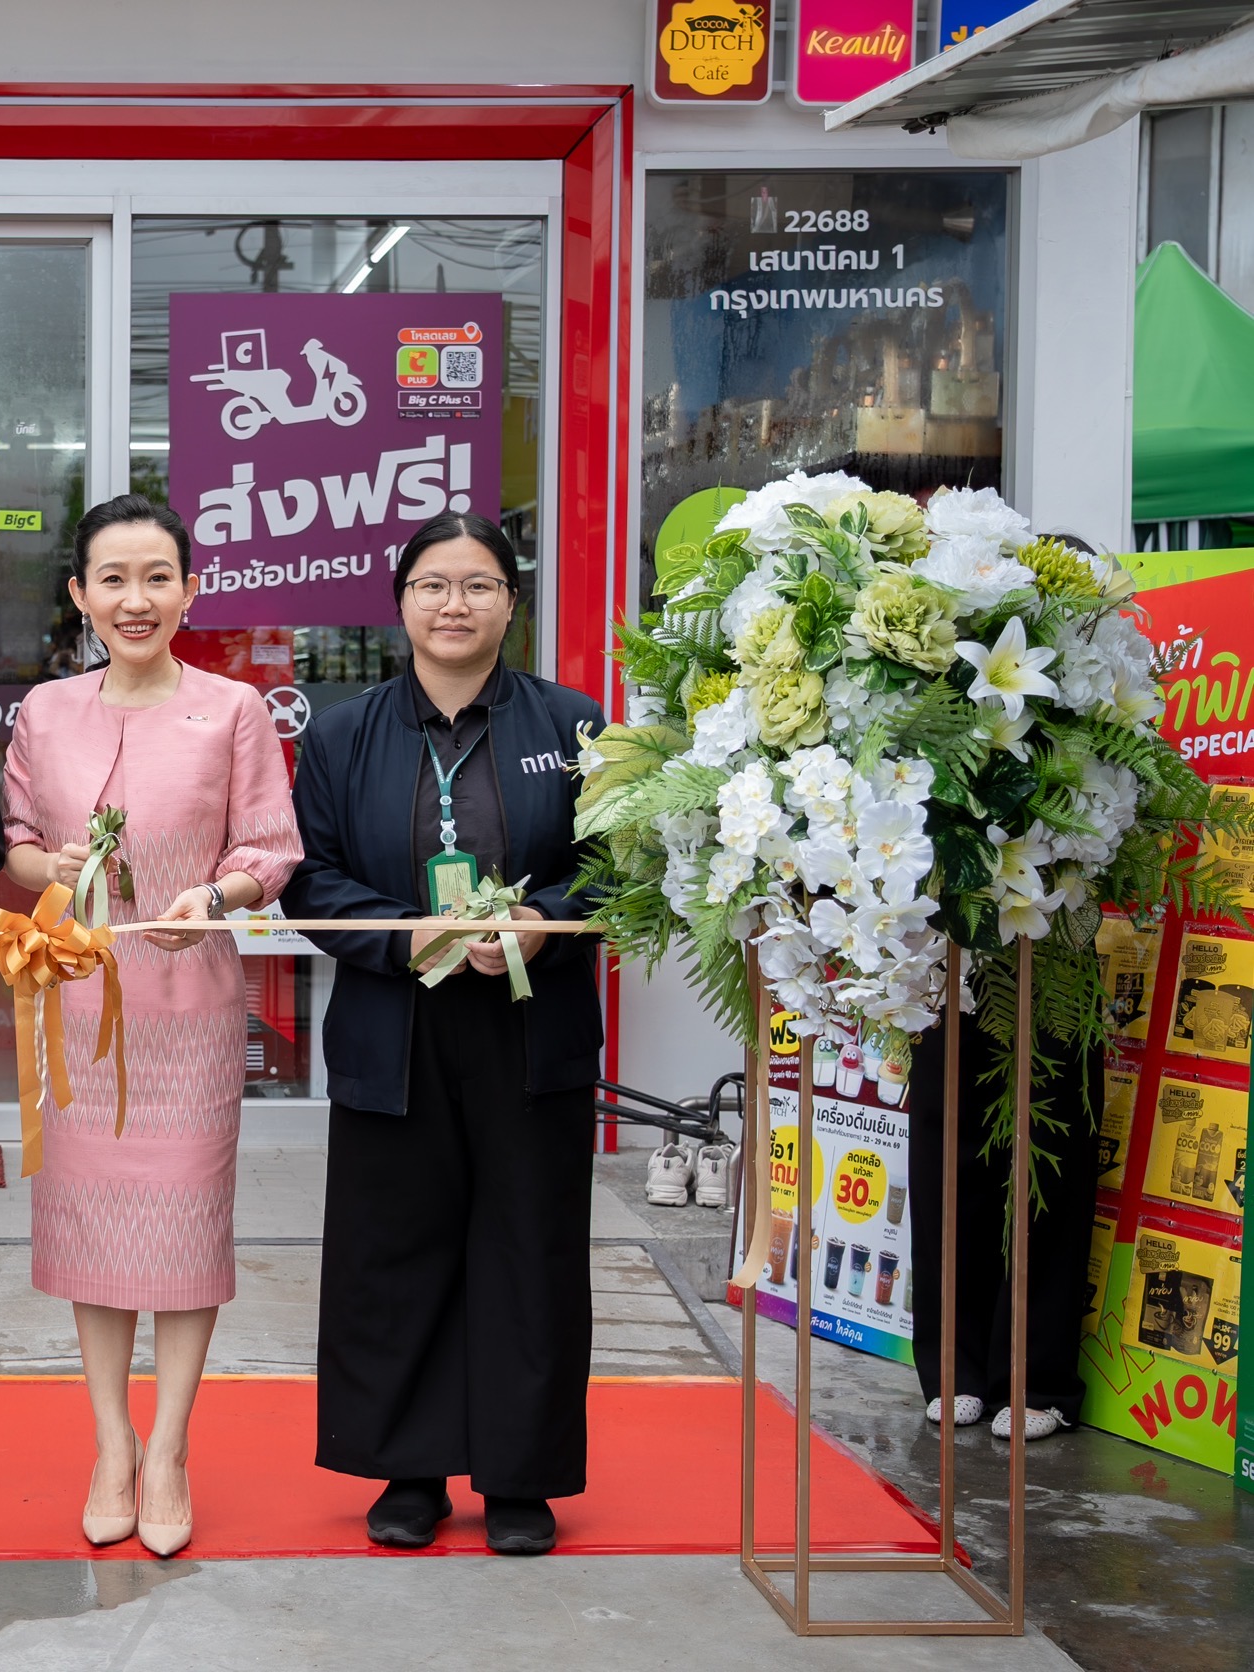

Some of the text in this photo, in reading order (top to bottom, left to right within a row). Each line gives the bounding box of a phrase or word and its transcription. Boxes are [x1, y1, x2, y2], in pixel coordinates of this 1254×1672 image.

[694, 19, 730, 30] COCOA
[670, 30, 754, 51] DUTCH
[806, 24, 907, 63] Keauty
[692, 64, 730, 82] Café
[784, 210, 870, 233] 22688
[749, 243, 904, 272] เสนานิคม 1
[709, 284, 945, 319] กรุงเทพมหานคร
[410, 330, 458, 341] โหลดเลย
[408, 395, 462, 407] Big C Plus
[193, 434, 472, 547] ส่งฟรี!
[3, 513, 37, 529] BigC
[195, 552, 372, 596] มื่อช้อปครบ
[1180, 729, 1254, 761] SPECIA
[1192, 944, 1219, 953] HELLO
[1168, 1088, 1197, 1099] HELLO
[816, 1101, 896, 1137] เครื่องดื่มเย็น
[787, 1142, 794, 1161] 1
[1176, 1137, 1199, 1150] COCO
[847, 1151, 881, 1168] ลดเหลือ
[853, 1165, 874, 1178] แก้วละ
[836, 1173, 879, 1208] 30 บาท
[1145, 1238, 1173, 1250] HELLO
[835, 1319, 864, 1344] ใกล้คุณ
[1213, 1332, 1231, 1352] 99
